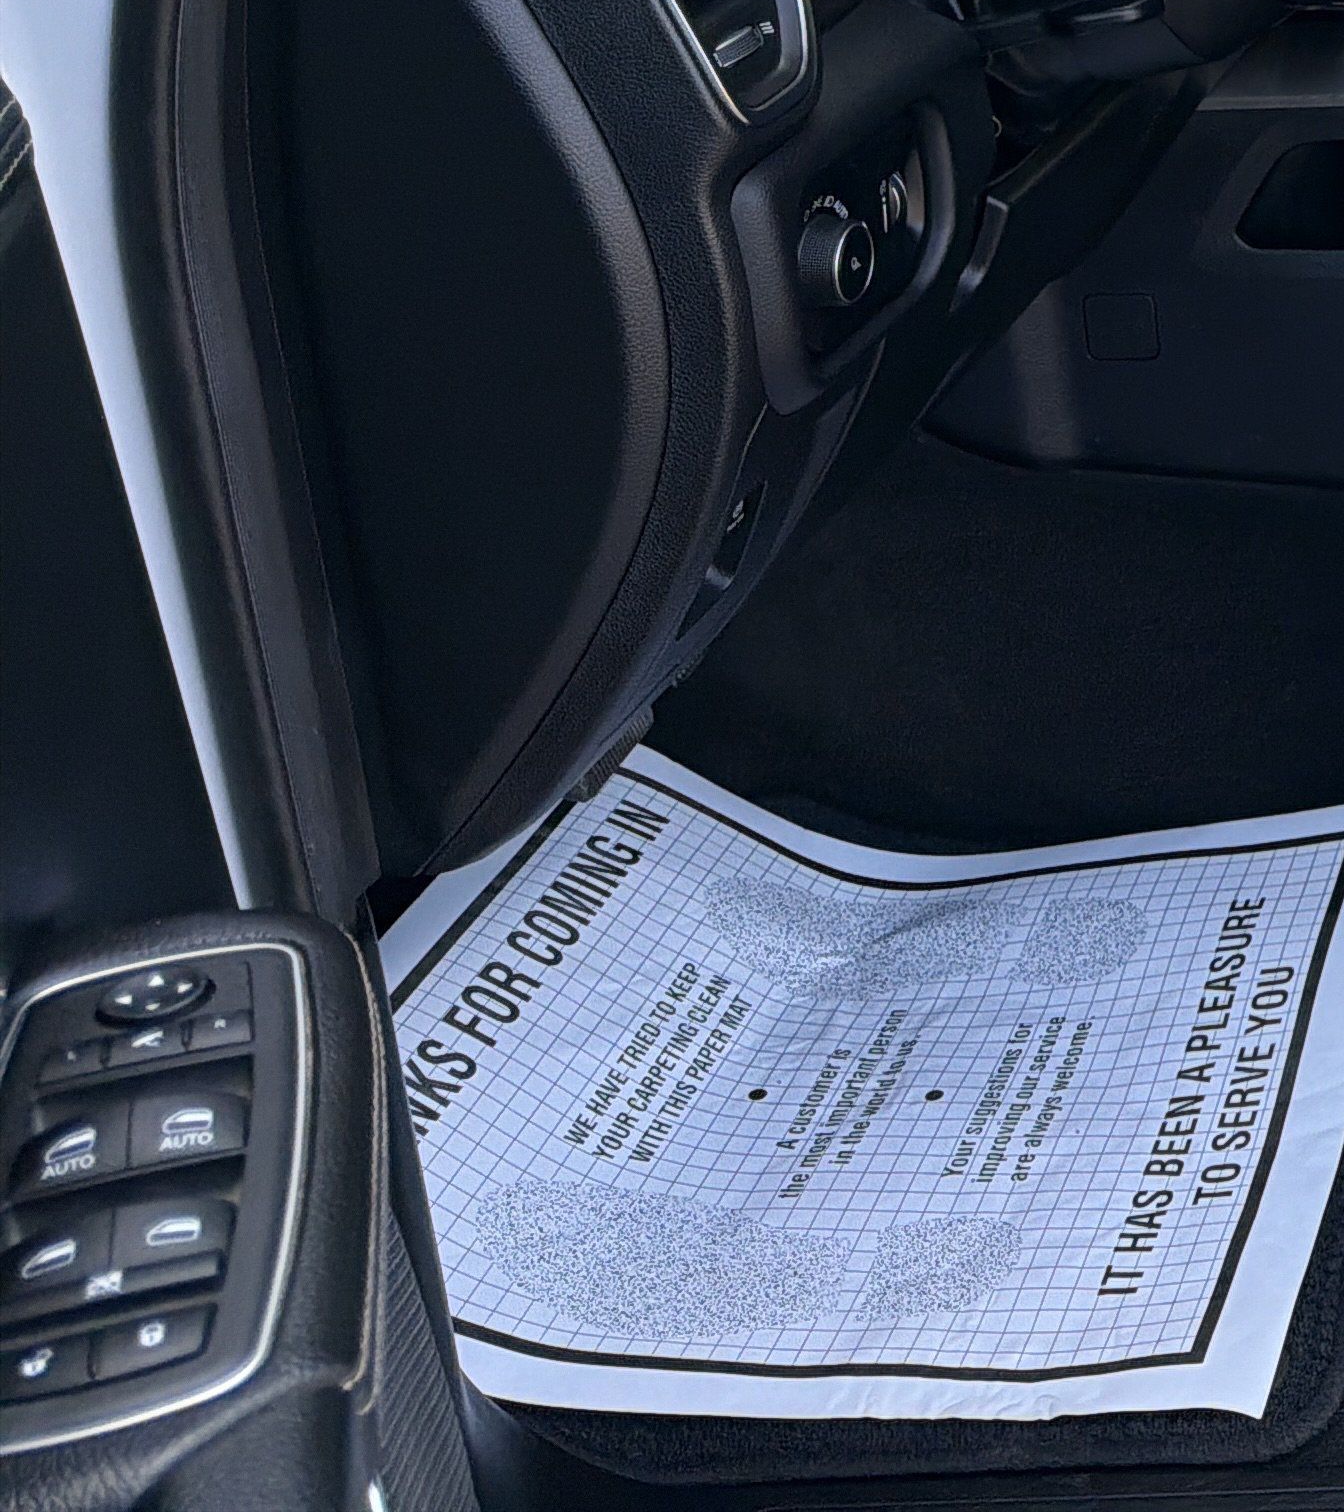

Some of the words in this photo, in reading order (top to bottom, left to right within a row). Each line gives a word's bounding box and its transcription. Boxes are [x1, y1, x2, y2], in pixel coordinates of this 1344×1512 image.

[406, 1038, 477, 1136] NKS
[442, 961, 542, 1048] FOR
[506, 835, 644, 966] COMING
[605, 799, 671, 842] IN
[1186, 897, 1266, 1054] PLEASURE
[1245, 966, 1295, 1036] YOU
[563, 1114, 597, 1145] WE
[585, 1068, 629, 1116] HAVE
[617, 1022, 661, 1069] TRIED
[649, 1001, 676, 1022] TO
[665, 962, 701, 1002] KEEP
[591, 1111, 639, 1159] YOUR
[627, 1023, 700, 1113] CARPETING
[687, 974, 731, 1024] CLEAN
[628, 1118, 672, 1163] WITH
[658, 1080, 696, 1118] THIS
[685, 1028, 732, 1082] PAPER
[719, 994, 752, 1030] MAT
[883, 1059, 905, 1076] to
[1177, 1061, 1215, 1083] A
[776, 1137, 799, 1150] A
[789, 1062, 841, 1135] customer
[828, 1048, 852, 1061] is
[778, 1173, 810, 1198] the
[800, 1130, 835, 1168] most
[819, 1058, 878, 1128] important
[868, 1009, 908, 1055] person
[841, 1120, 870, 1146] the
[862, 1079, 896, 1118] world
[940, 1139, 976, 1177] Your
[966, 1048, 1022, 1135] suggestions
[1008, 1023, 1033, 1044] for
[971, 1103, 1031, 1183] improving
[1016, 1075, 1040, 1100] our
[1029, 1016, 1066, 1072] service
[1144, 1096, 1206, 1177] BEEN
[1212, 1043, 1276, 1151] SERVE
[40, 1154, 96, 1180] AUTO
[159, 1131, 214, 1152] AUTO
[828, 1149, 855, 1165] in
[1010, 1153, 1035, 1182] are
[1024, 1096, 1063, 1148] always
[1114, 1191, 1173, 1252] HAS
[1193, 1163, 1242, 1206] TO
[1097, 1265, 1144, 1297] IT
